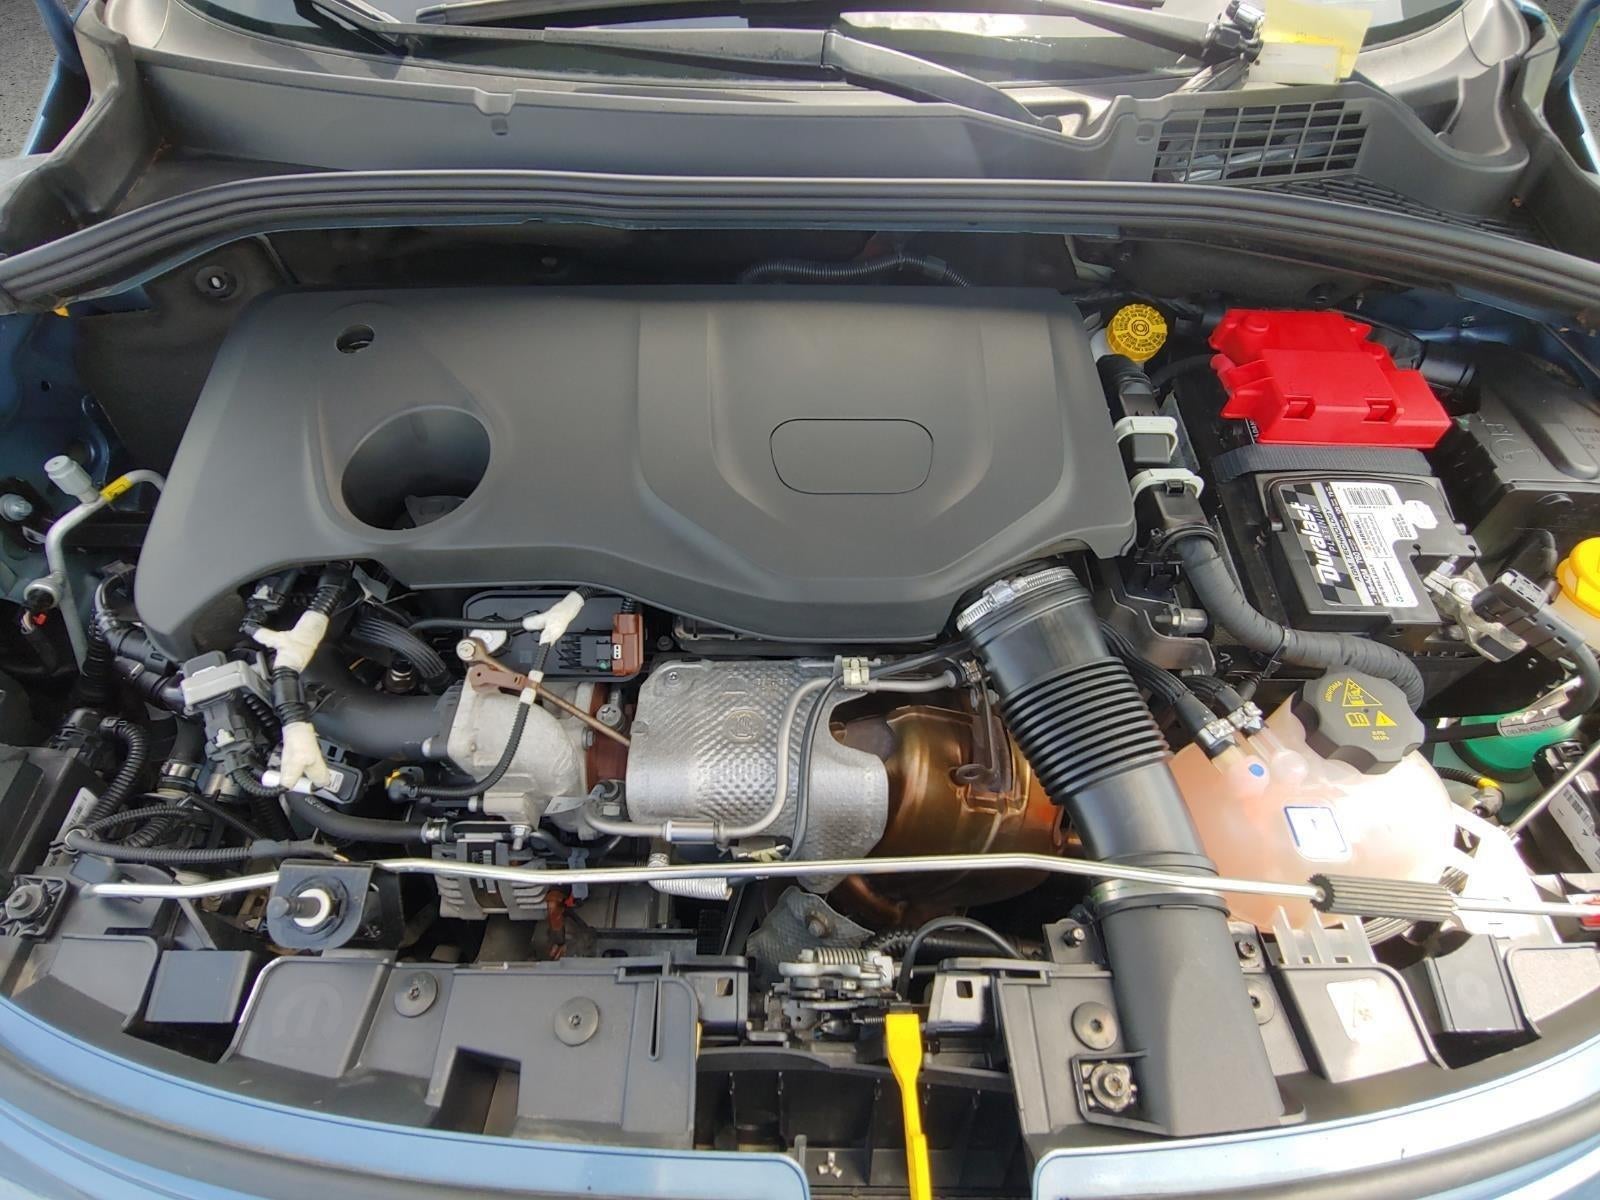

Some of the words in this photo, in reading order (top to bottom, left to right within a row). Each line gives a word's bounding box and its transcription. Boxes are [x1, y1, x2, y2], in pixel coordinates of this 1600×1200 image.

[1289, 501, 1340, 583] Duralast
[1310, 503, 1338, 552] PLATINUM
[1323, 505, 1351, 559] TECHNOLOGY
[1346, 562, 1361, 582] AGM
